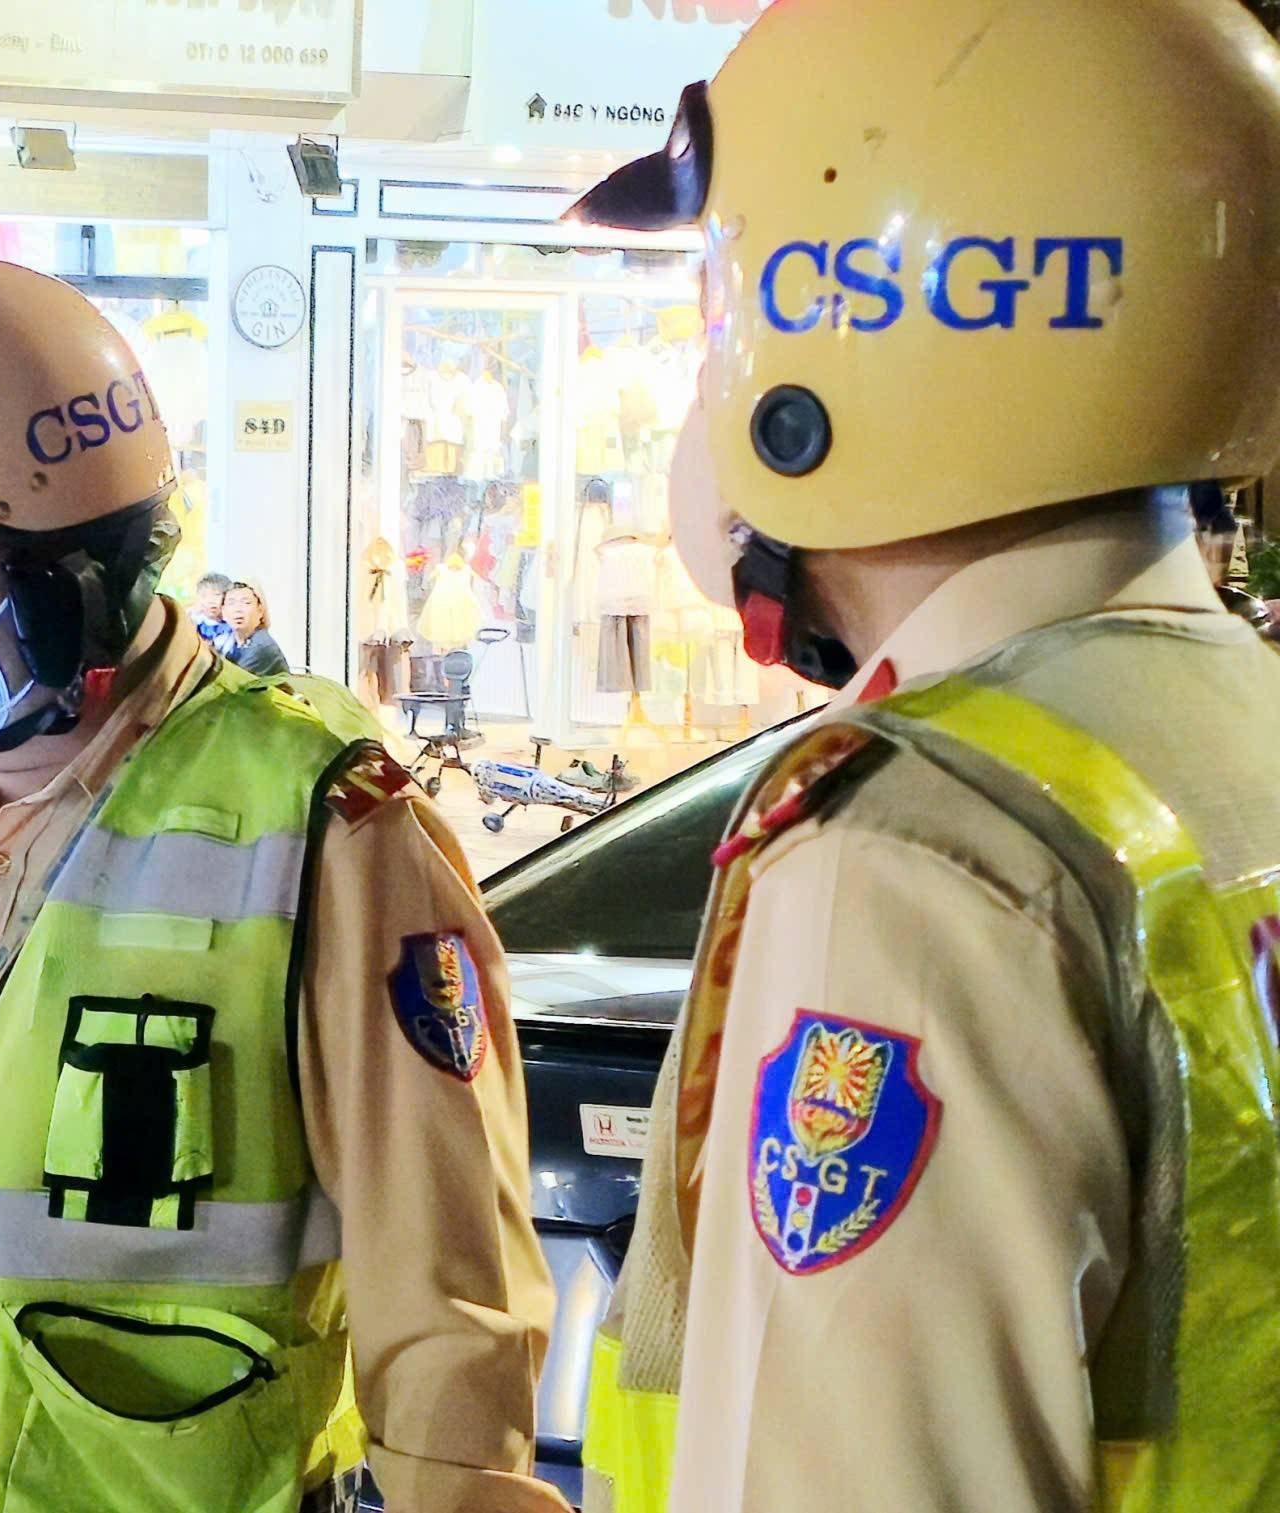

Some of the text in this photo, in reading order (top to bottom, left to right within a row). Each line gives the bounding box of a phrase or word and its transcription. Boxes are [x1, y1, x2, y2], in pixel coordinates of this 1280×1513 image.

[759, 236, 1123, 333] CSGT
[251, 321, 287, 341] GIN
[759, 1137, 887, 1199] CSGT
